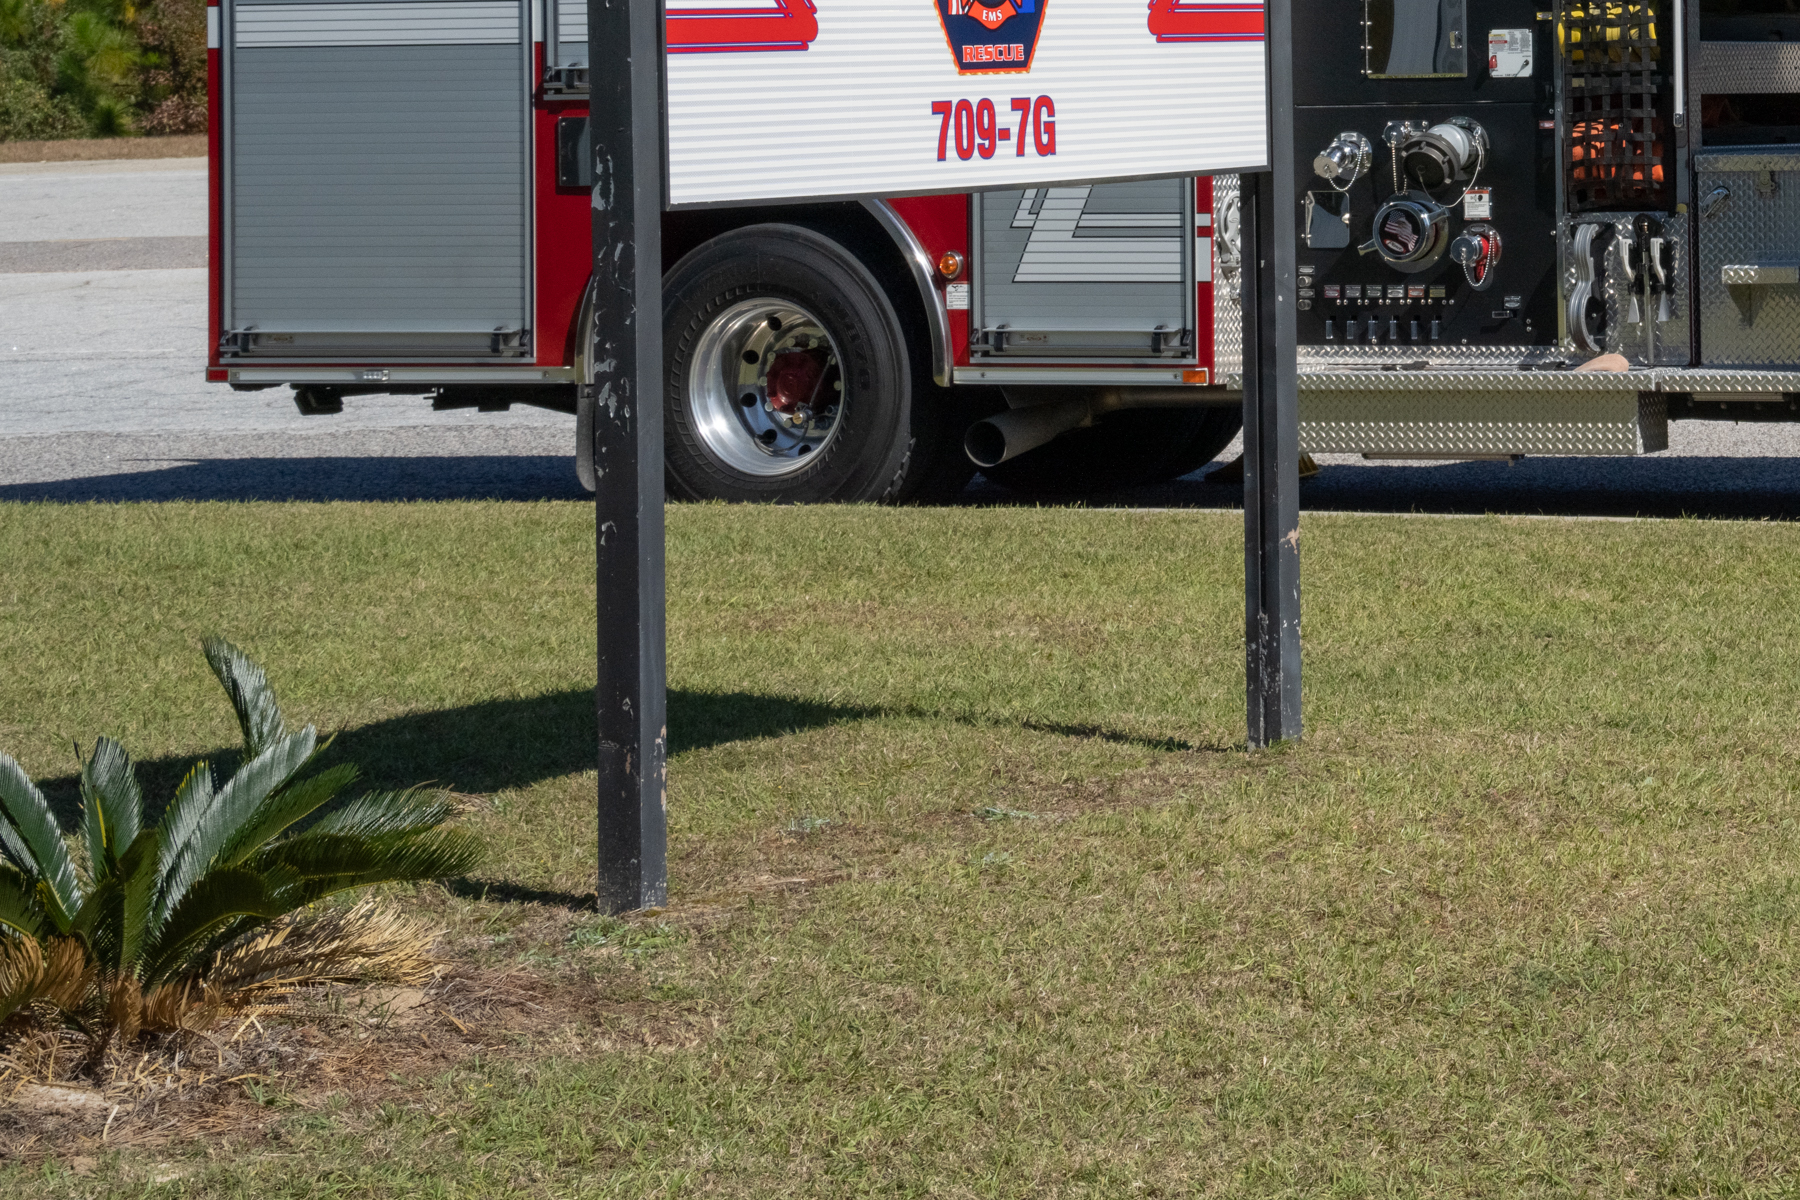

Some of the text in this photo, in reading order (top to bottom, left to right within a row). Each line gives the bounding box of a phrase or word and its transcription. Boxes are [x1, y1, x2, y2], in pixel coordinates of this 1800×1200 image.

[982, 9, 1003, 22] EMS
[962, 44, 1025, 62] RESCUE
[931, 95, 1056, 162] 709-7G
